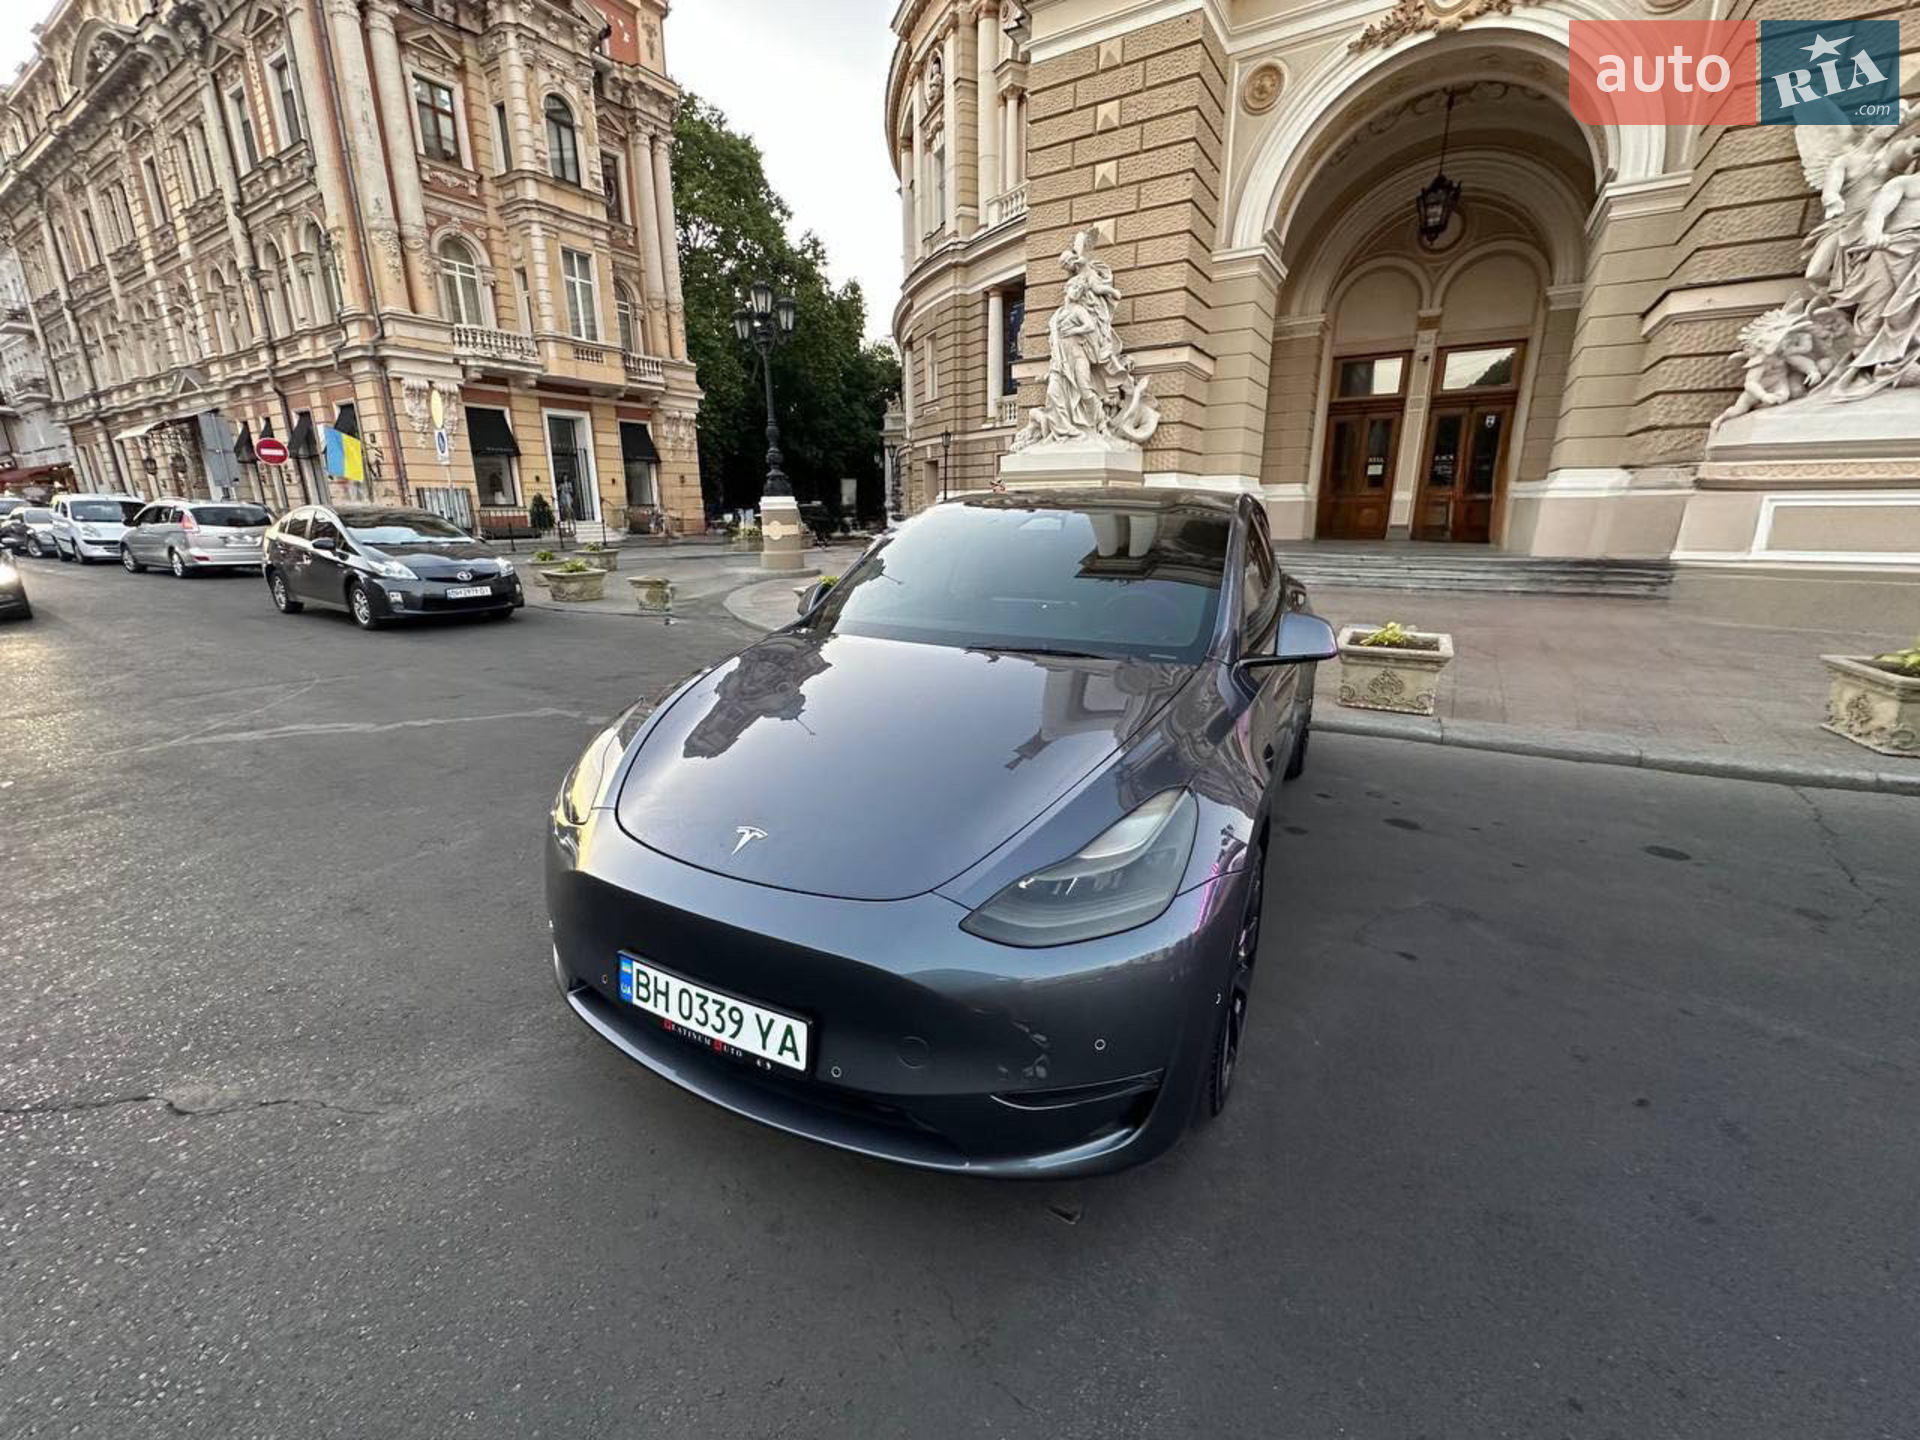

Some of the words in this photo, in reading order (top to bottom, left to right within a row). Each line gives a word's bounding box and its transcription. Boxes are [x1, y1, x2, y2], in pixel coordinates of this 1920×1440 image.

[636, 968, 670, 1013] BH
[678, 988, 744, 1039] 0339
[755, 1013, 800, 1062] YA
